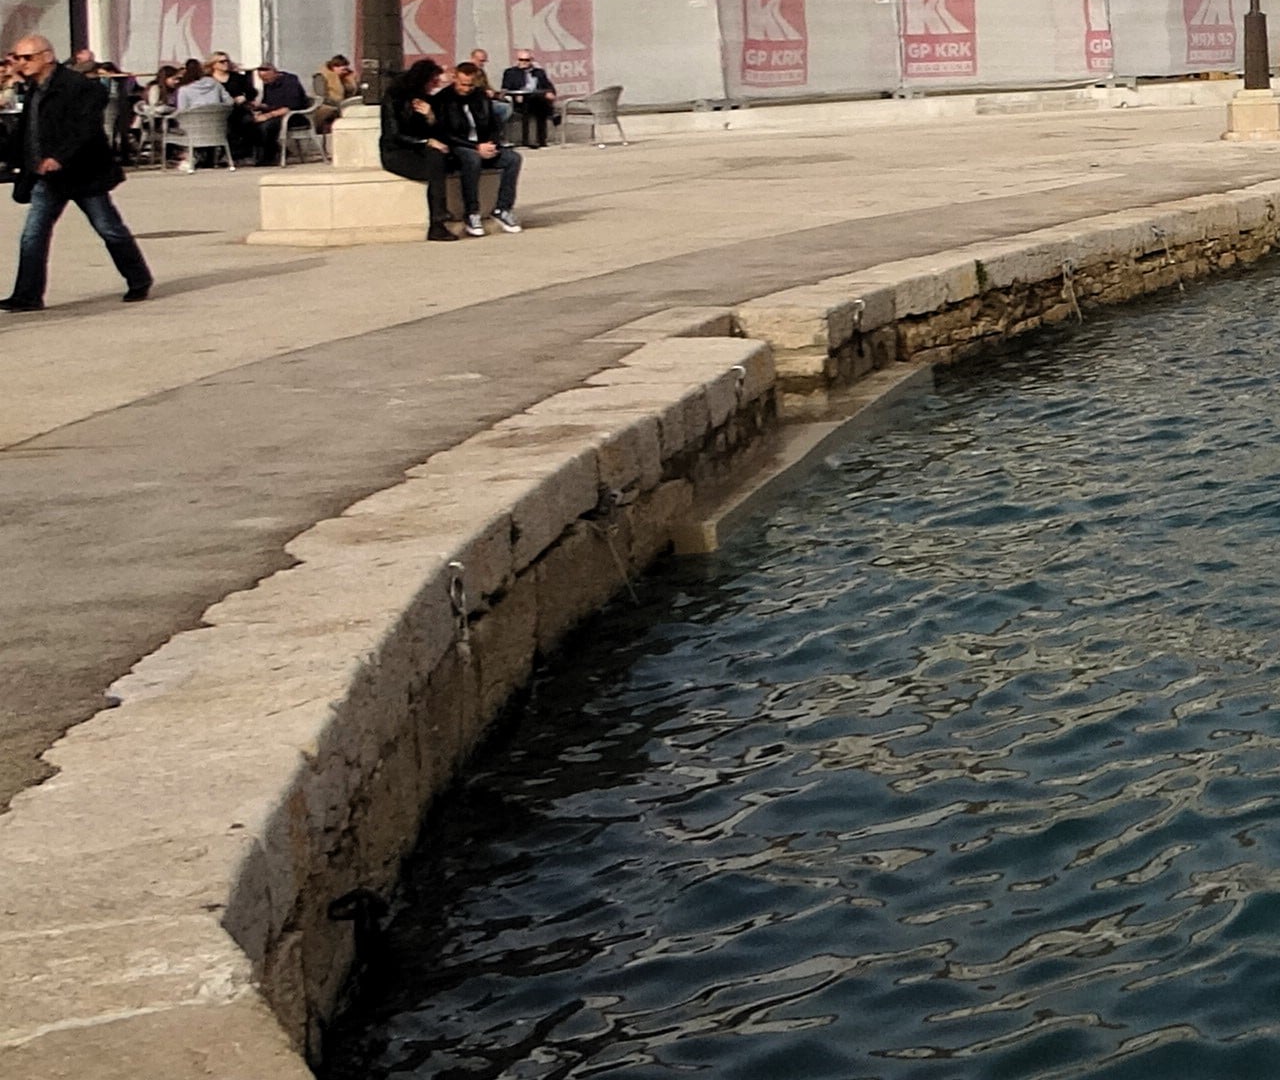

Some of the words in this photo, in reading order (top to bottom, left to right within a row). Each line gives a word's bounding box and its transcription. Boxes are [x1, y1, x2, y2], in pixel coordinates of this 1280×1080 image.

[745, 48, 767, 65] GP
[771, 48, 804, 66] KRK
[908, 42, 929, 58] GP
[935, 41, 972, 58] KRK
[545, 60, 588, 78] KRK
